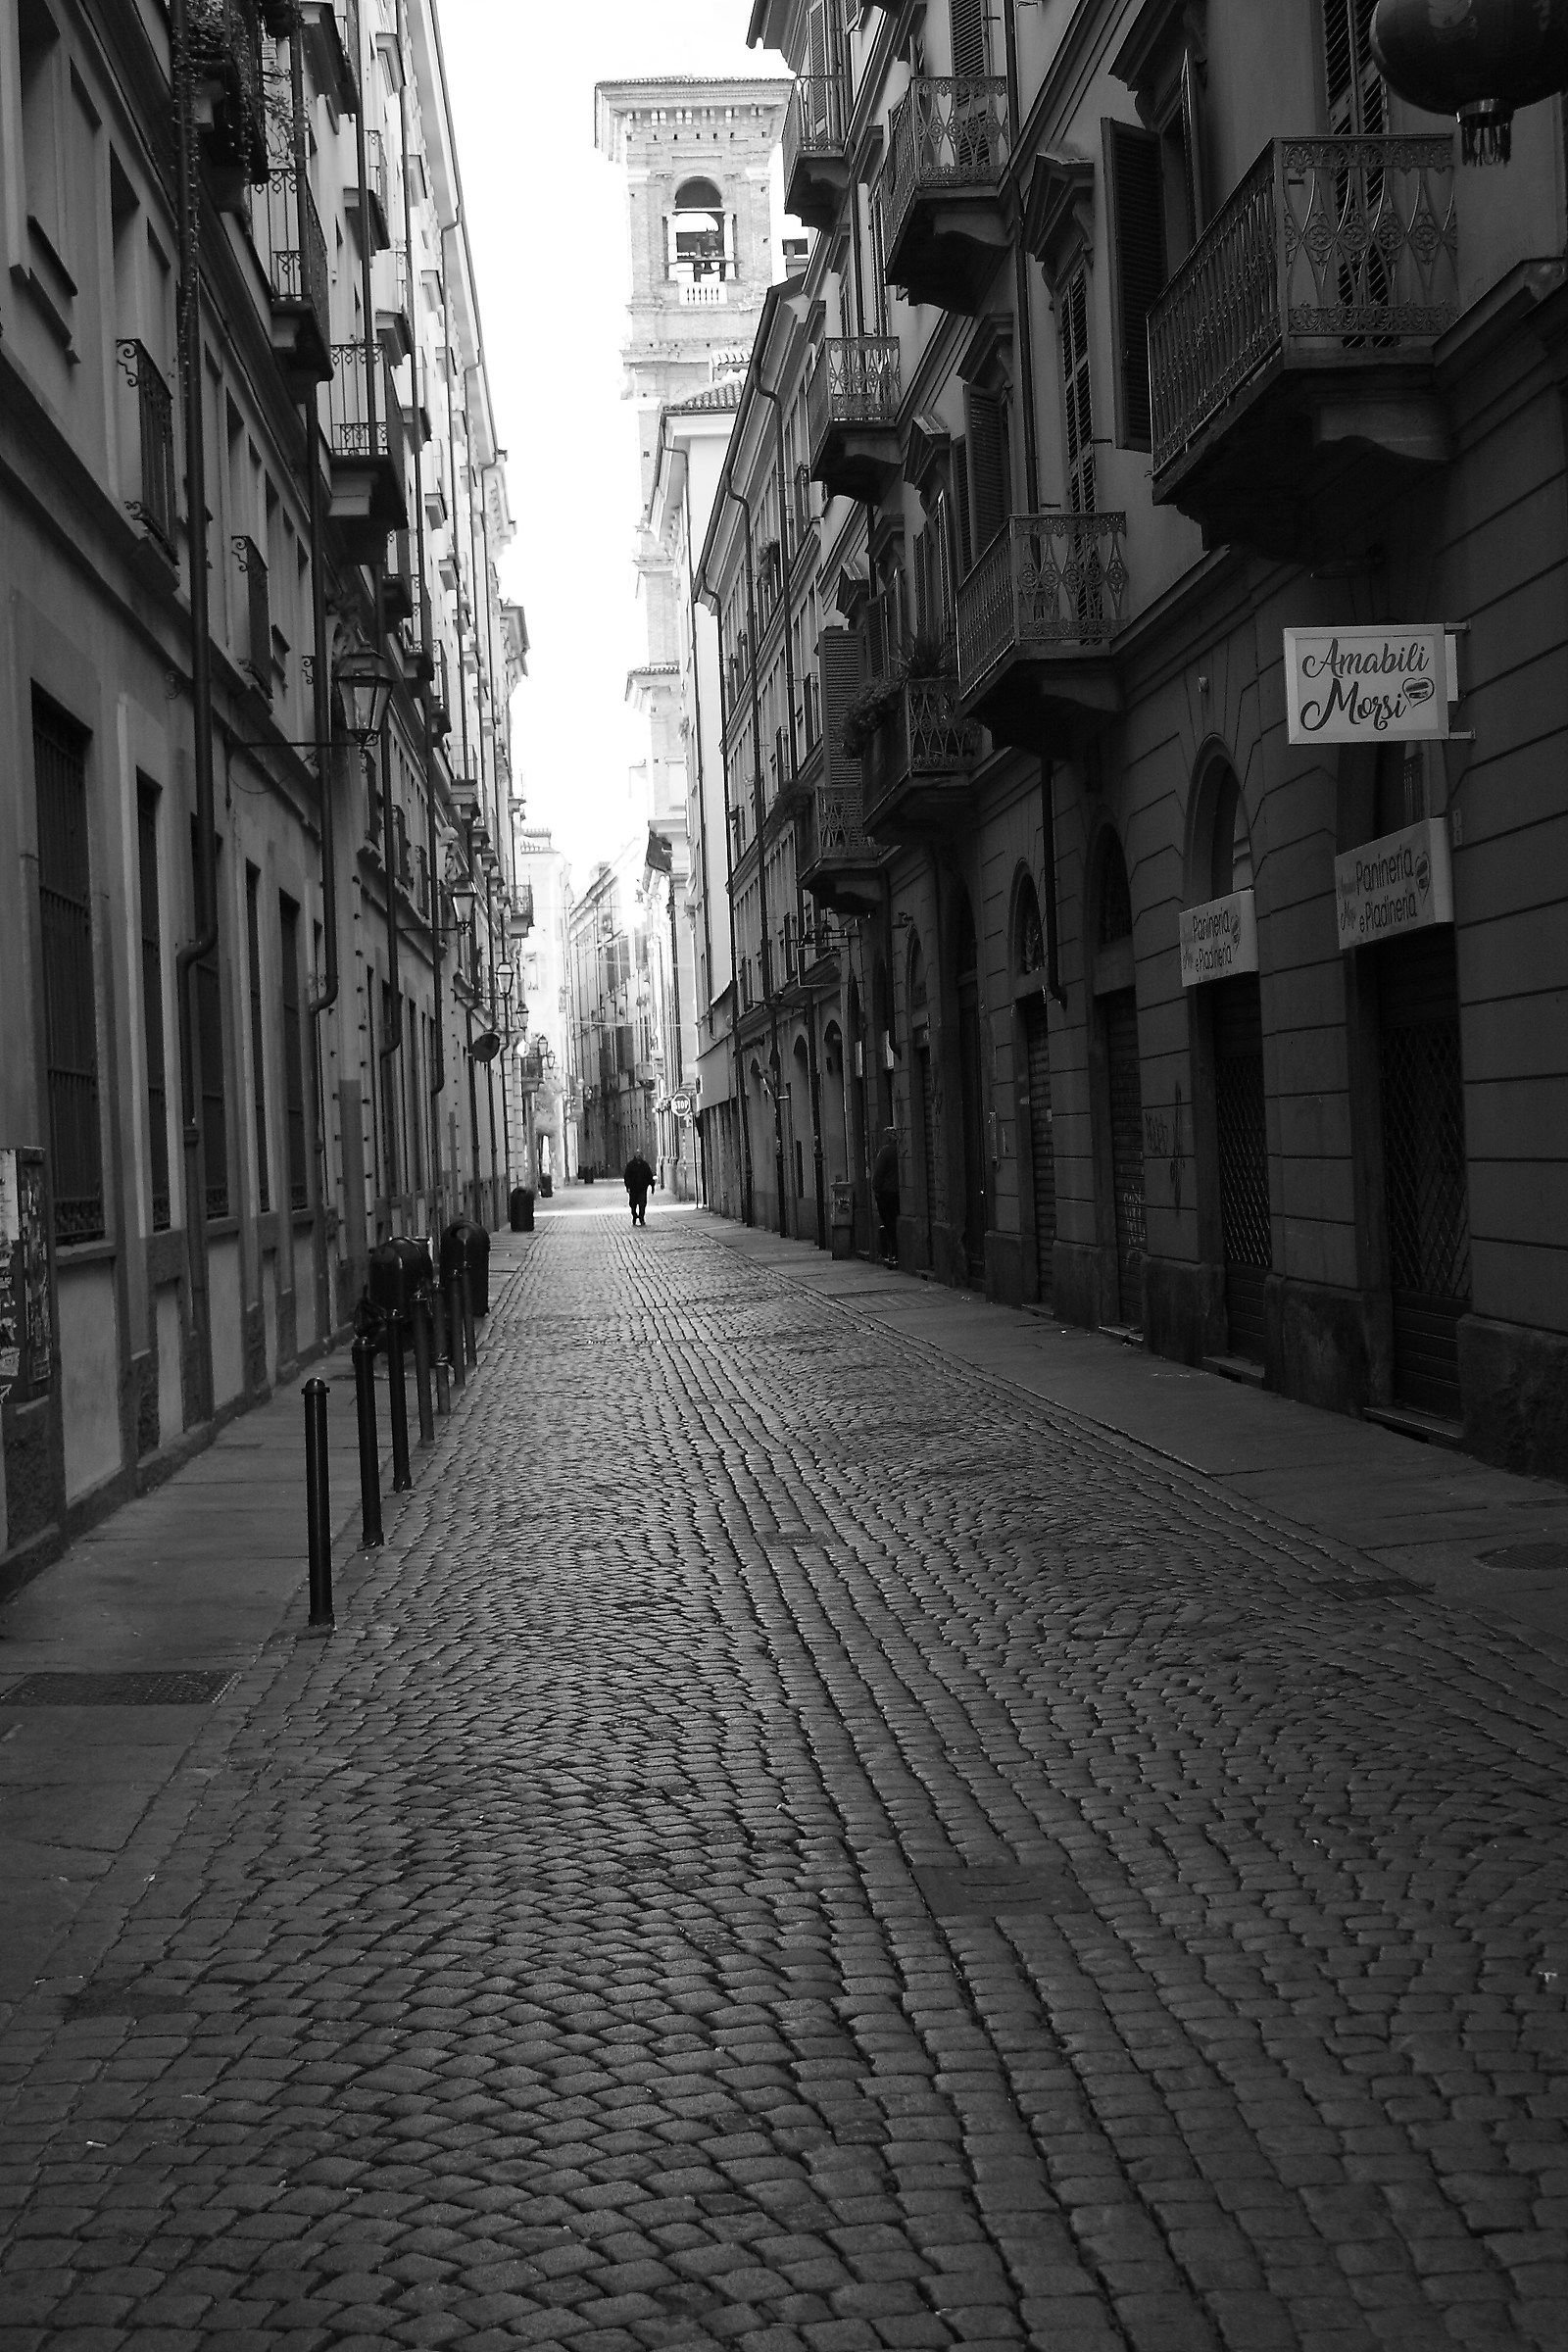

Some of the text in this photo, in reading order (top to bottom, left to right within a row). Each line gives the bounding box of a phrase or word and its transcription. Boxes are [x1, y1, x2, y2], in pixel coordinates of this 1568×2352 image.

[1302, 639, 1430, 678] Amabili
[1300, 677, 1407, 730] Morsi
[1356, 846, 1414, 895] Panineria
[1194, 906, 1230, 942] Panineria
[1365, 890, 1417, 931] Piadineria
[673, 1100, 689, 1109] STOP
